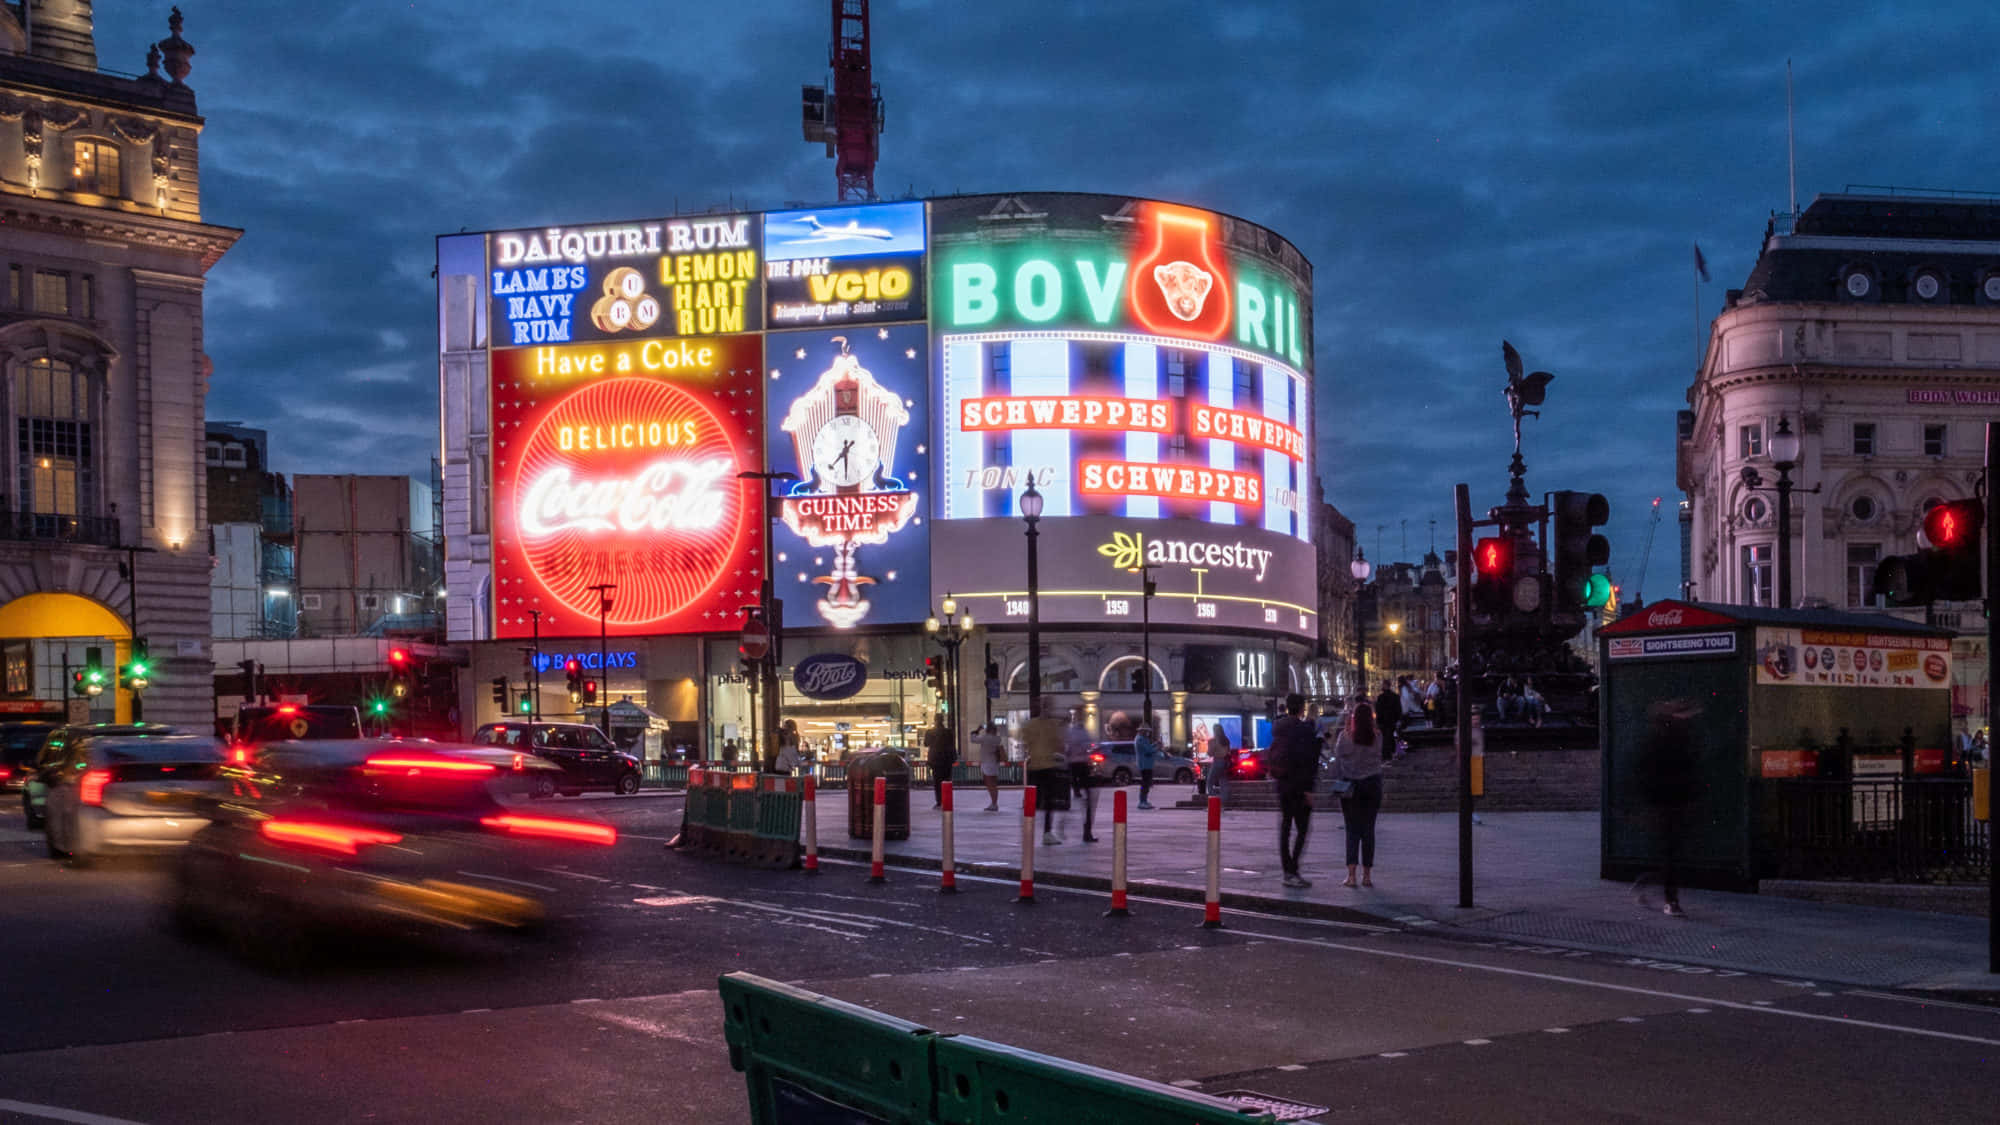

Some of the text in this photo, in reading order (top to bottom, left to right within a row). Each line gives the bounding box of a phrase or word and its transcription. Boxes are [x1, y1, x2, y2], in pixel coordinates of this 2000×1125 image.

[500, 220, 748, 263] DAÏQUIRI RUM
[494, 267, 585, 294] LAMB'S
[660, 250, 756, 284] LEMON
[768, 261, 791, 279] THE
[627, 277, 640, 292] U
[674, 281, 747, 309] HART
[811, 270, 909, 301] VC10
[508, 293, 573, 320] NAVY
[640, 303, 654, 318] M
[514, 319, 571, 344] RUM
[678, 307, 744, 336] RUM
[536, 340, 712, 376] Have a Coke
[1910, 390, 2000, 402] BODY WORL
[963, 399, 1168, 428] SCHWEPPES
[559, 421, 697, 450] DELICIOUS
[964, 466, 1056, 489] TONC
[1085, 463, 1259, 502] SCHWEPPES
[798, 496, 899, 515] GUINNESS
[822, 514, 873, 532] TIME
[1147, 540, 1273, 582] ancestry
[1005, 601, 1029, 615] 1940
[1105, 600, 1128, 615] 1950
[1645, 637, 1731, 650] SIGHTSEEING TOUR
[804, 662, 856, 692] Boots
[884, 668, 927, 680] beauty
[1236, 652, 1265, 688] GAP
